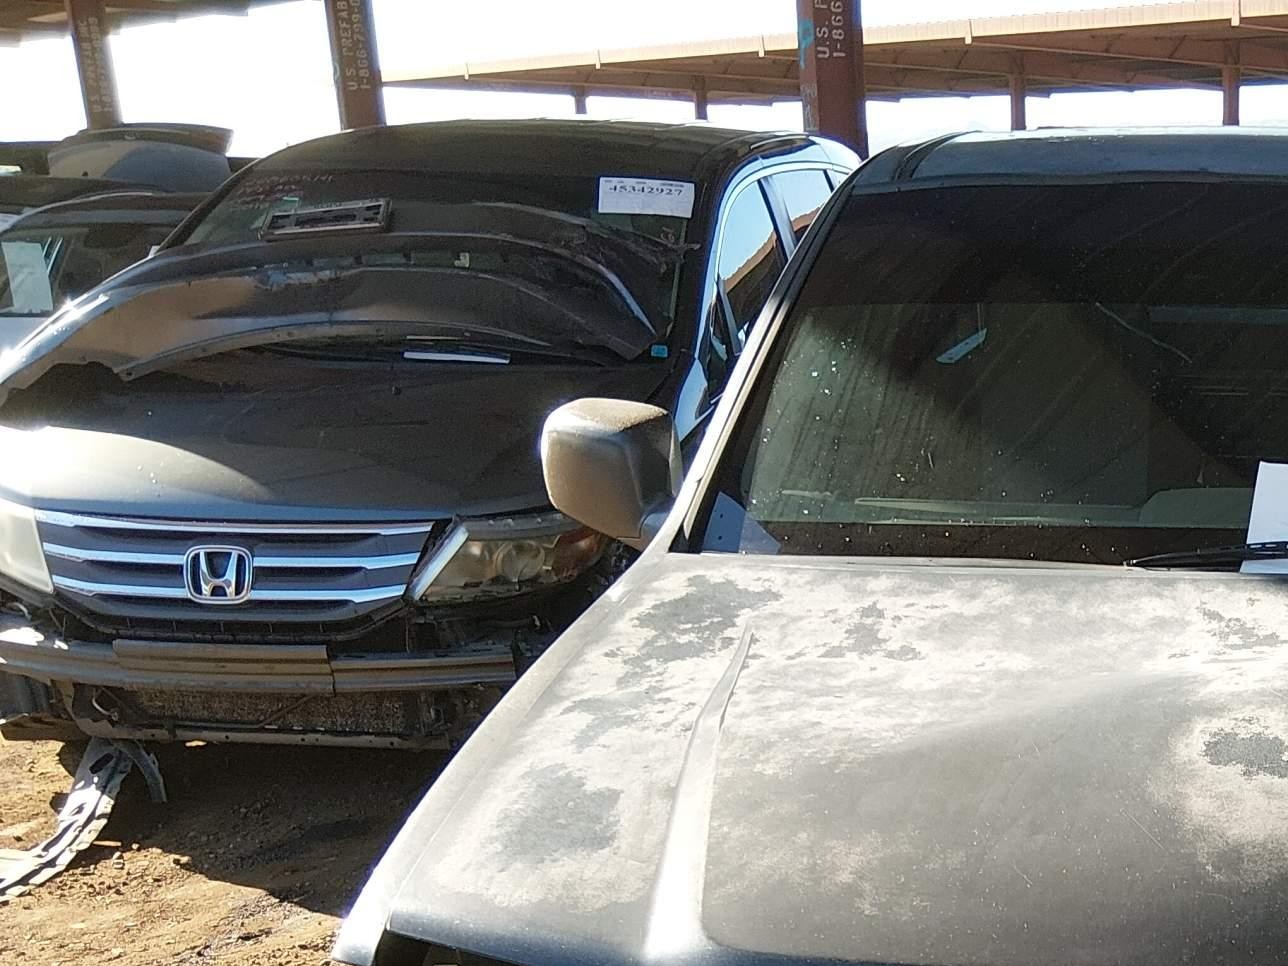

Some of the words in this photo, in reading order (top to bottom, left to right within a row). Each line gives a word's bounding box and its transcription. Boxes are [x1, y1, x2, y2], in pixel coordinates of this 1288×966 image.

[336, 0, 354, 56] PREFAB
[816, 21, 830, 58] U.S.
[609, 184, 684, 196] 45342927
